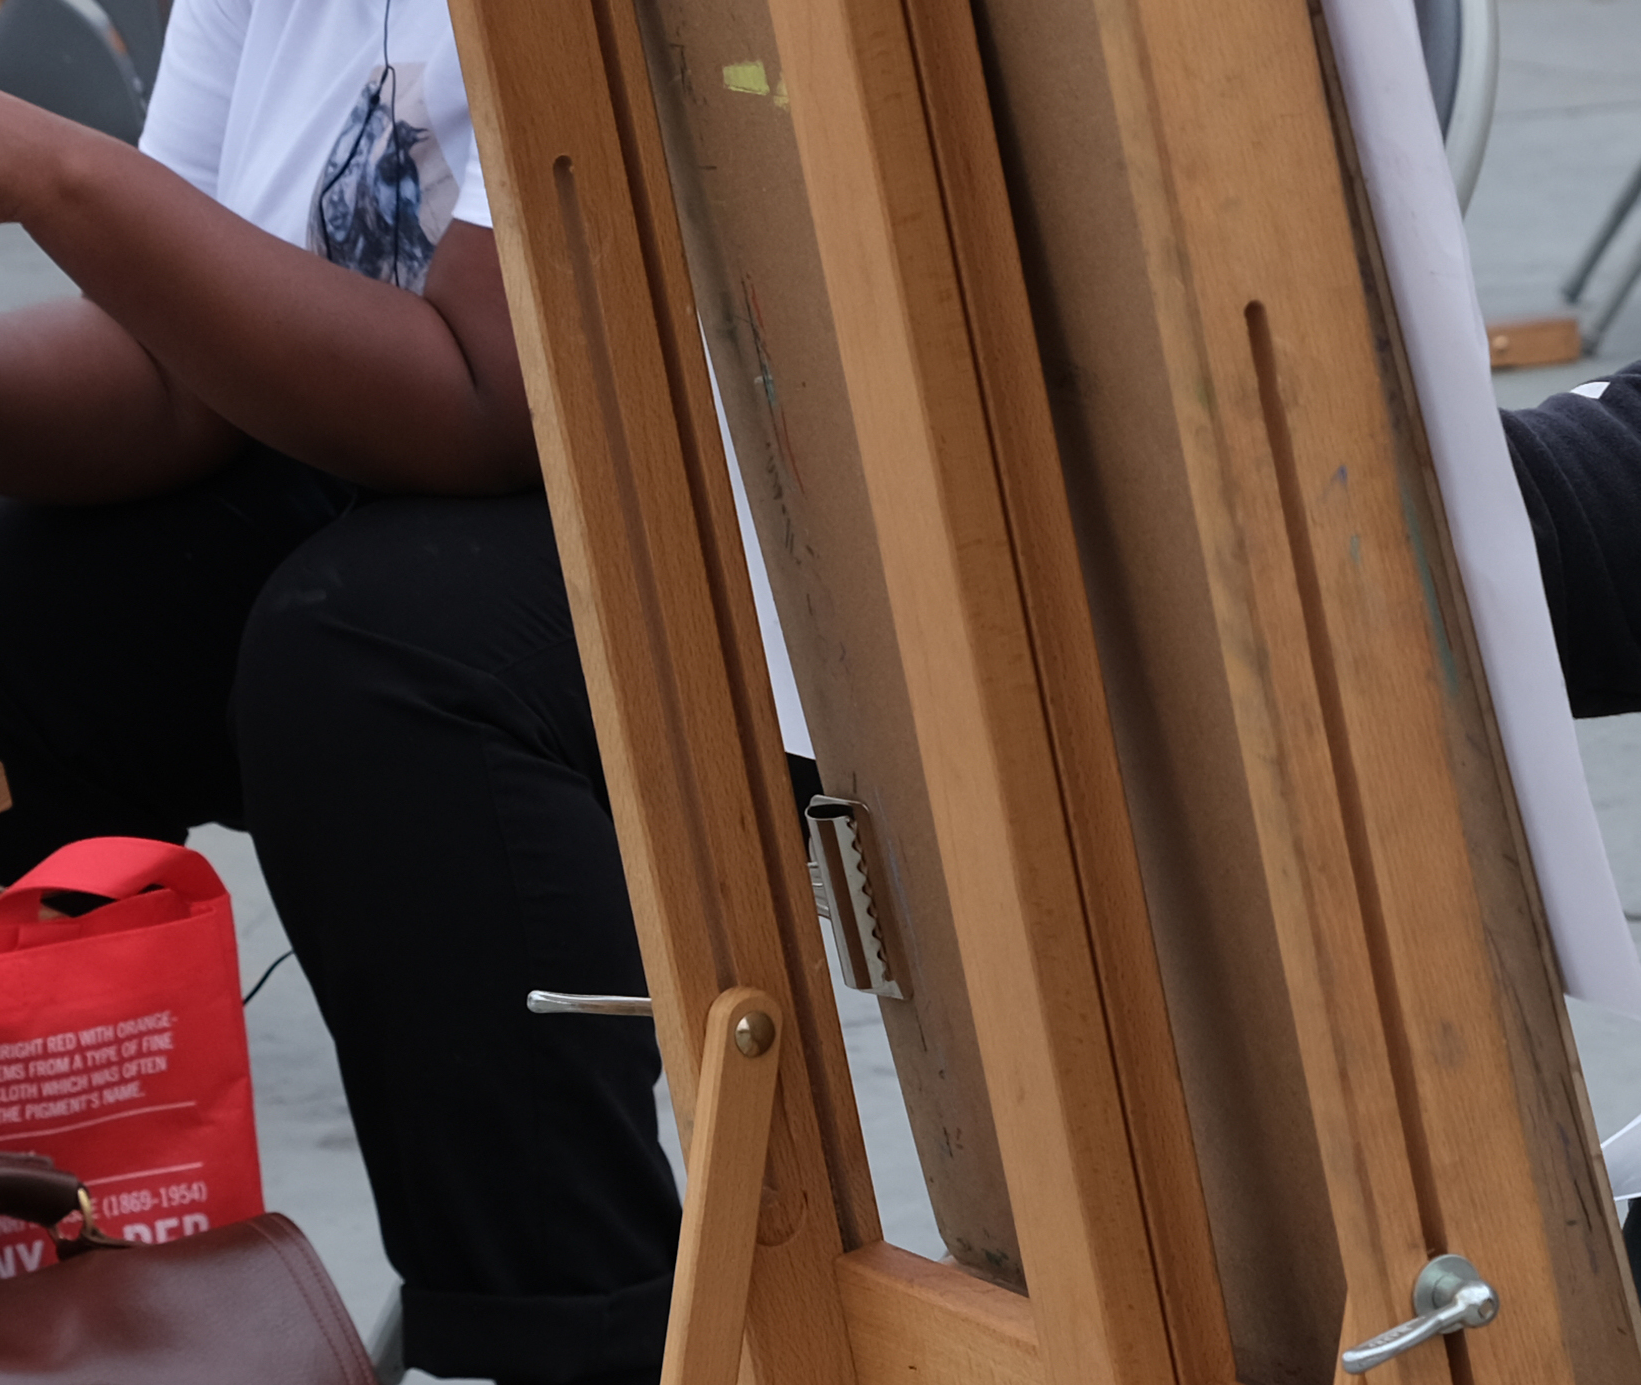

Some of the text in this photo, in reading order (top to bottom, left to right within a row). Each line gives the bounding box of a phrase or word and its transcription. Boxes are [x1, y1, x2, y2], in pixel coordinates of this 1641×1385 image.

[29, 1056, 71, 1078] FROM
[72, 1053, 84, 1071] A
[86, 1044, 119, 1066] TYPE
[121, 1039, 139, 1058] OF
[142, 1031, 174, 1053] FINE
[46, 1031, 77, 1054] RED
[78, 1024, 115, 1047] WITH
[41, 1073, 89, 1097] WHICH
[91, 1065, 120, 1088] WAS
[122, 1055, 168, 1079] OFTEN
[25, 1092, 101, 1121] PIGMENT'S
[102, 1181, 207, 1219] (1869-1954)
